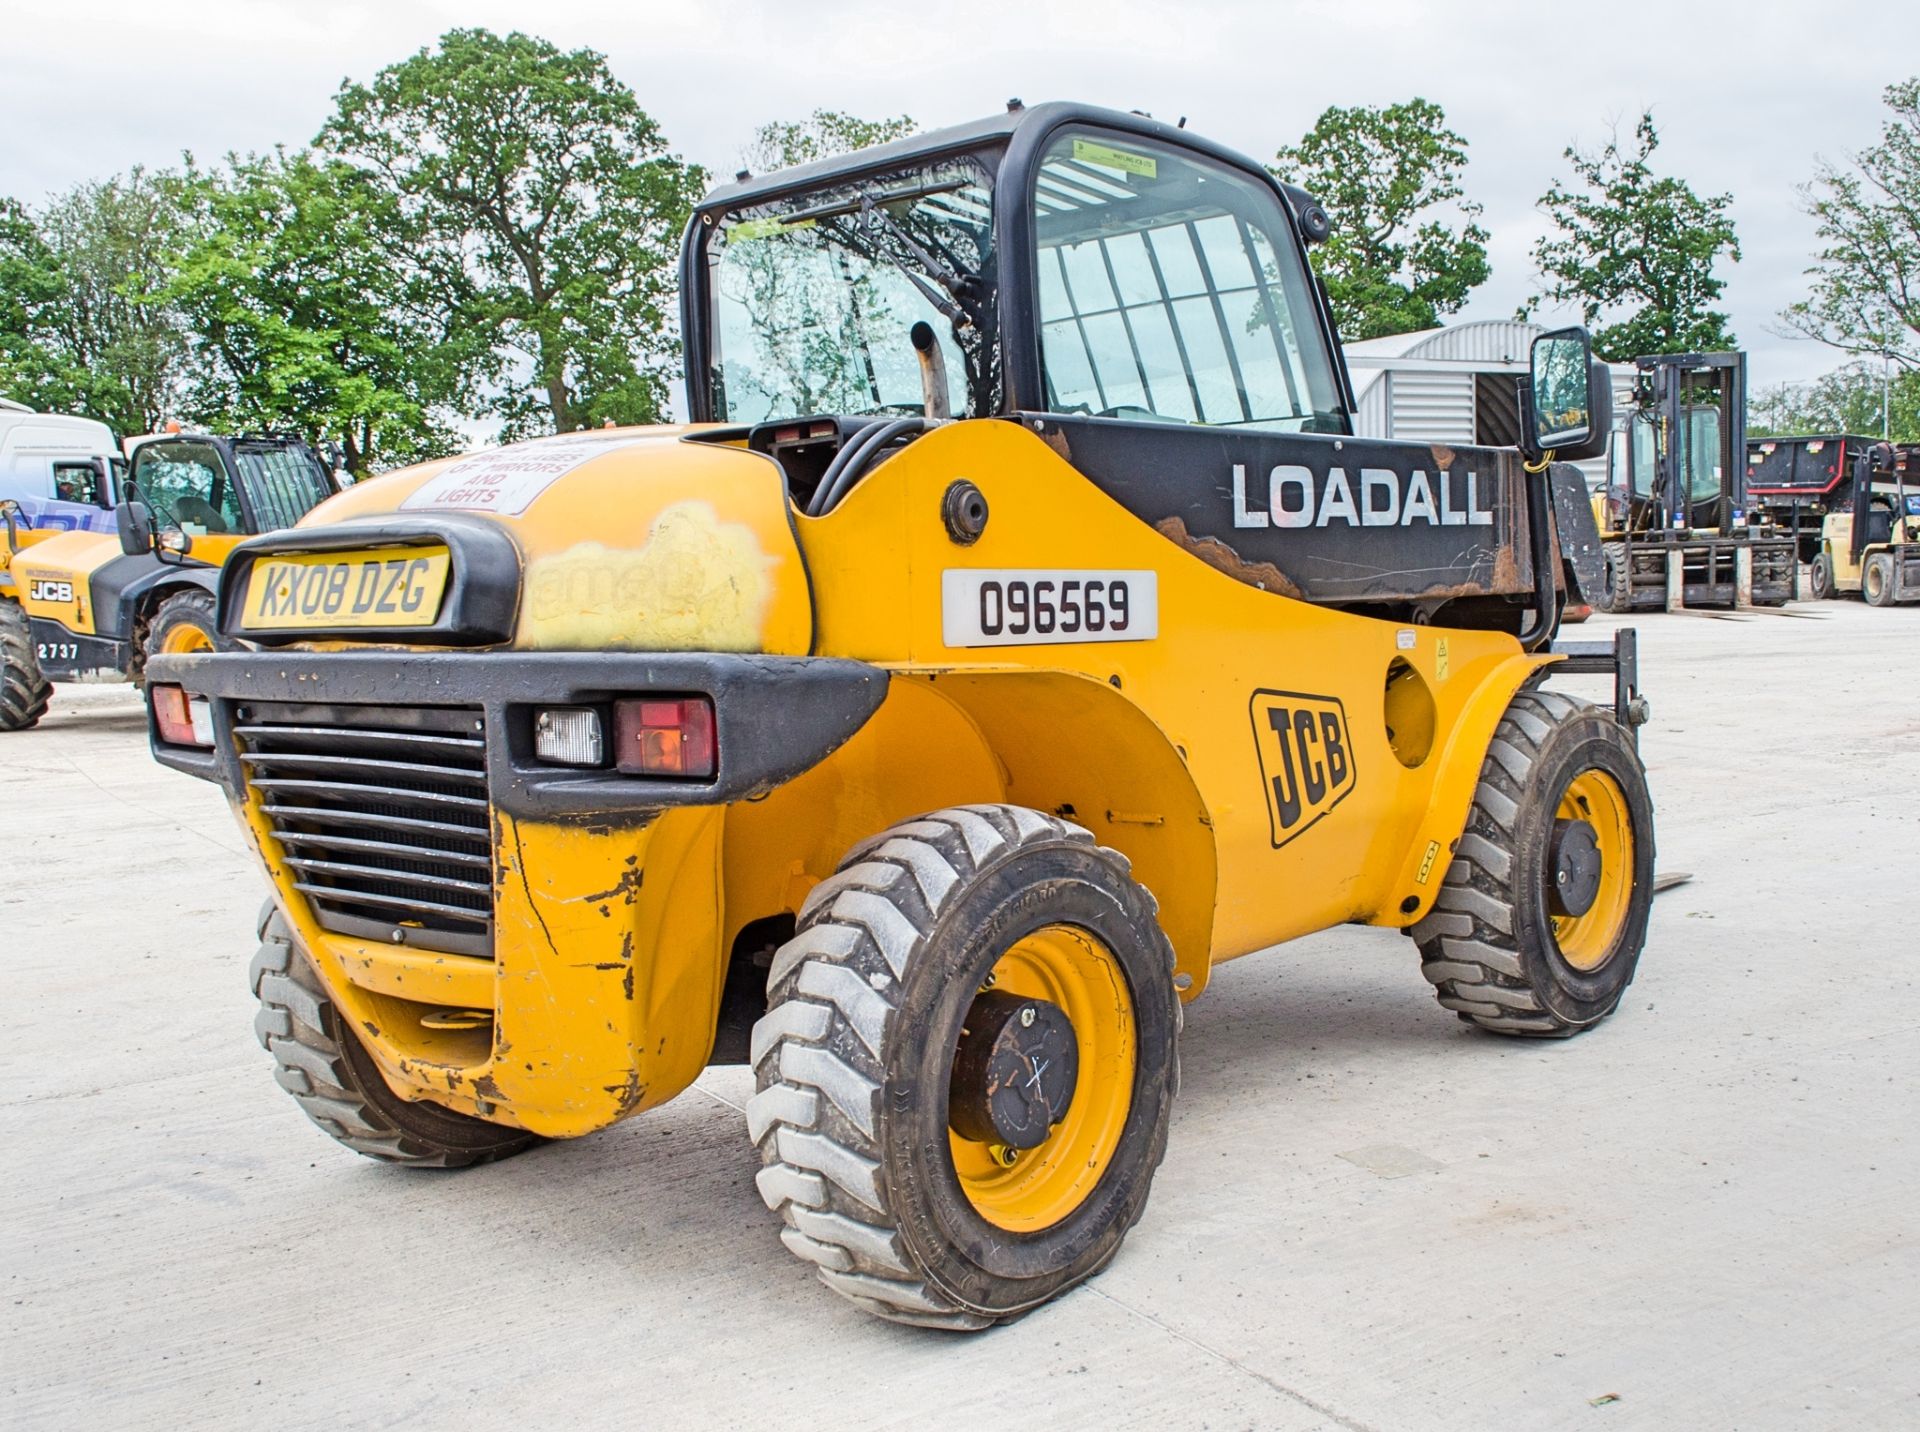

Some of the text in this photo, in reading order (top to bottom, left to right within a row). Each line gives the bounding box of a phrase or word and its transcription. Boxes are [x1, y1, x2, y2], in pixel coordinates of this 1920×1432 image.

[449, 463, 568, 473] OF MIRRORS
[463, 474, 507, 485] AND
[434, 489, 501, 503] LIGHTS
[1232, 464, 1493, 528] LOADALL
[31, 581, 73, 602] JCB
[259, 558, 429, 617] KX08 DZG
[980, 580, 1129, 636] 096569
[38, 643, 78, 659] 2737
[1267, 707, 1347, 829] JCB
